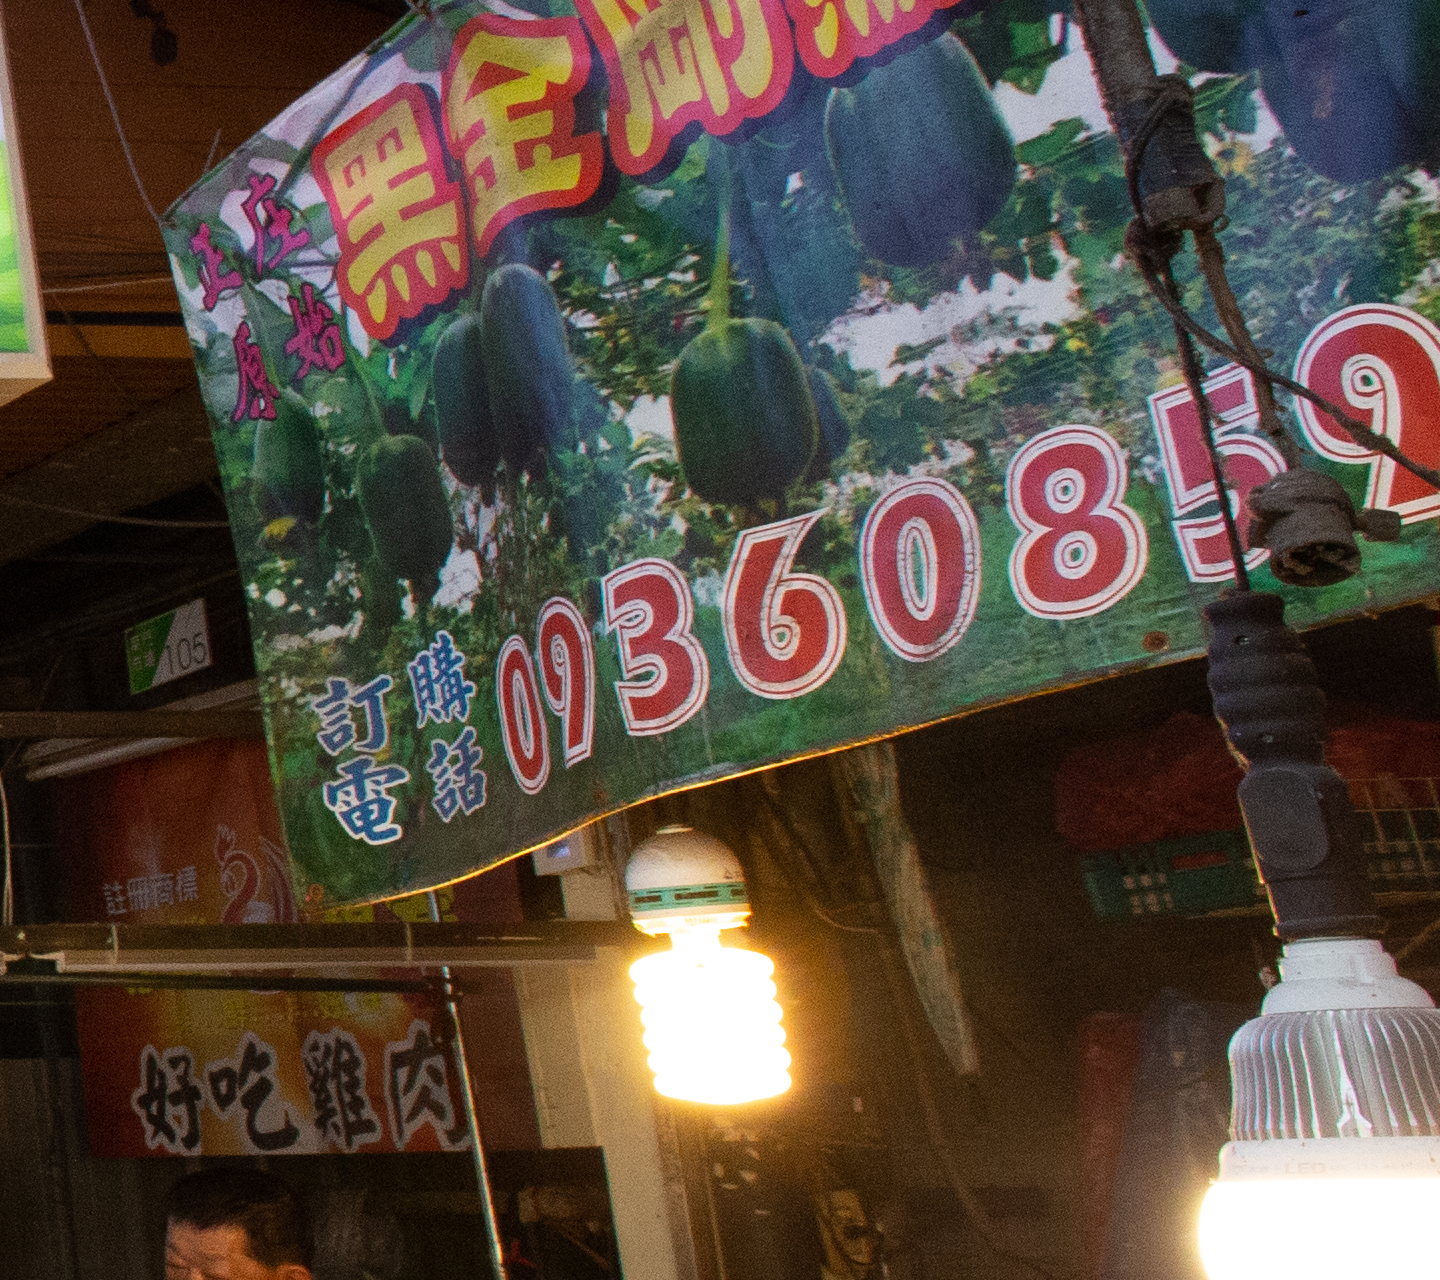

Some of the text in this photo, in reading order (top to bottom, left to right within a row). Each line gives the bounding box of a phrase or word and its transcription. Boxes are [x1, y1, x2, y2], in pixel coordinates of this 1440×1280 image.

[164, 632, 206, 675] 105
[313, 630, 478, 757] 訂購
[322, 738, 487, 847] 電話
[131, 1020, 474, 1155] 好吃雞肉
